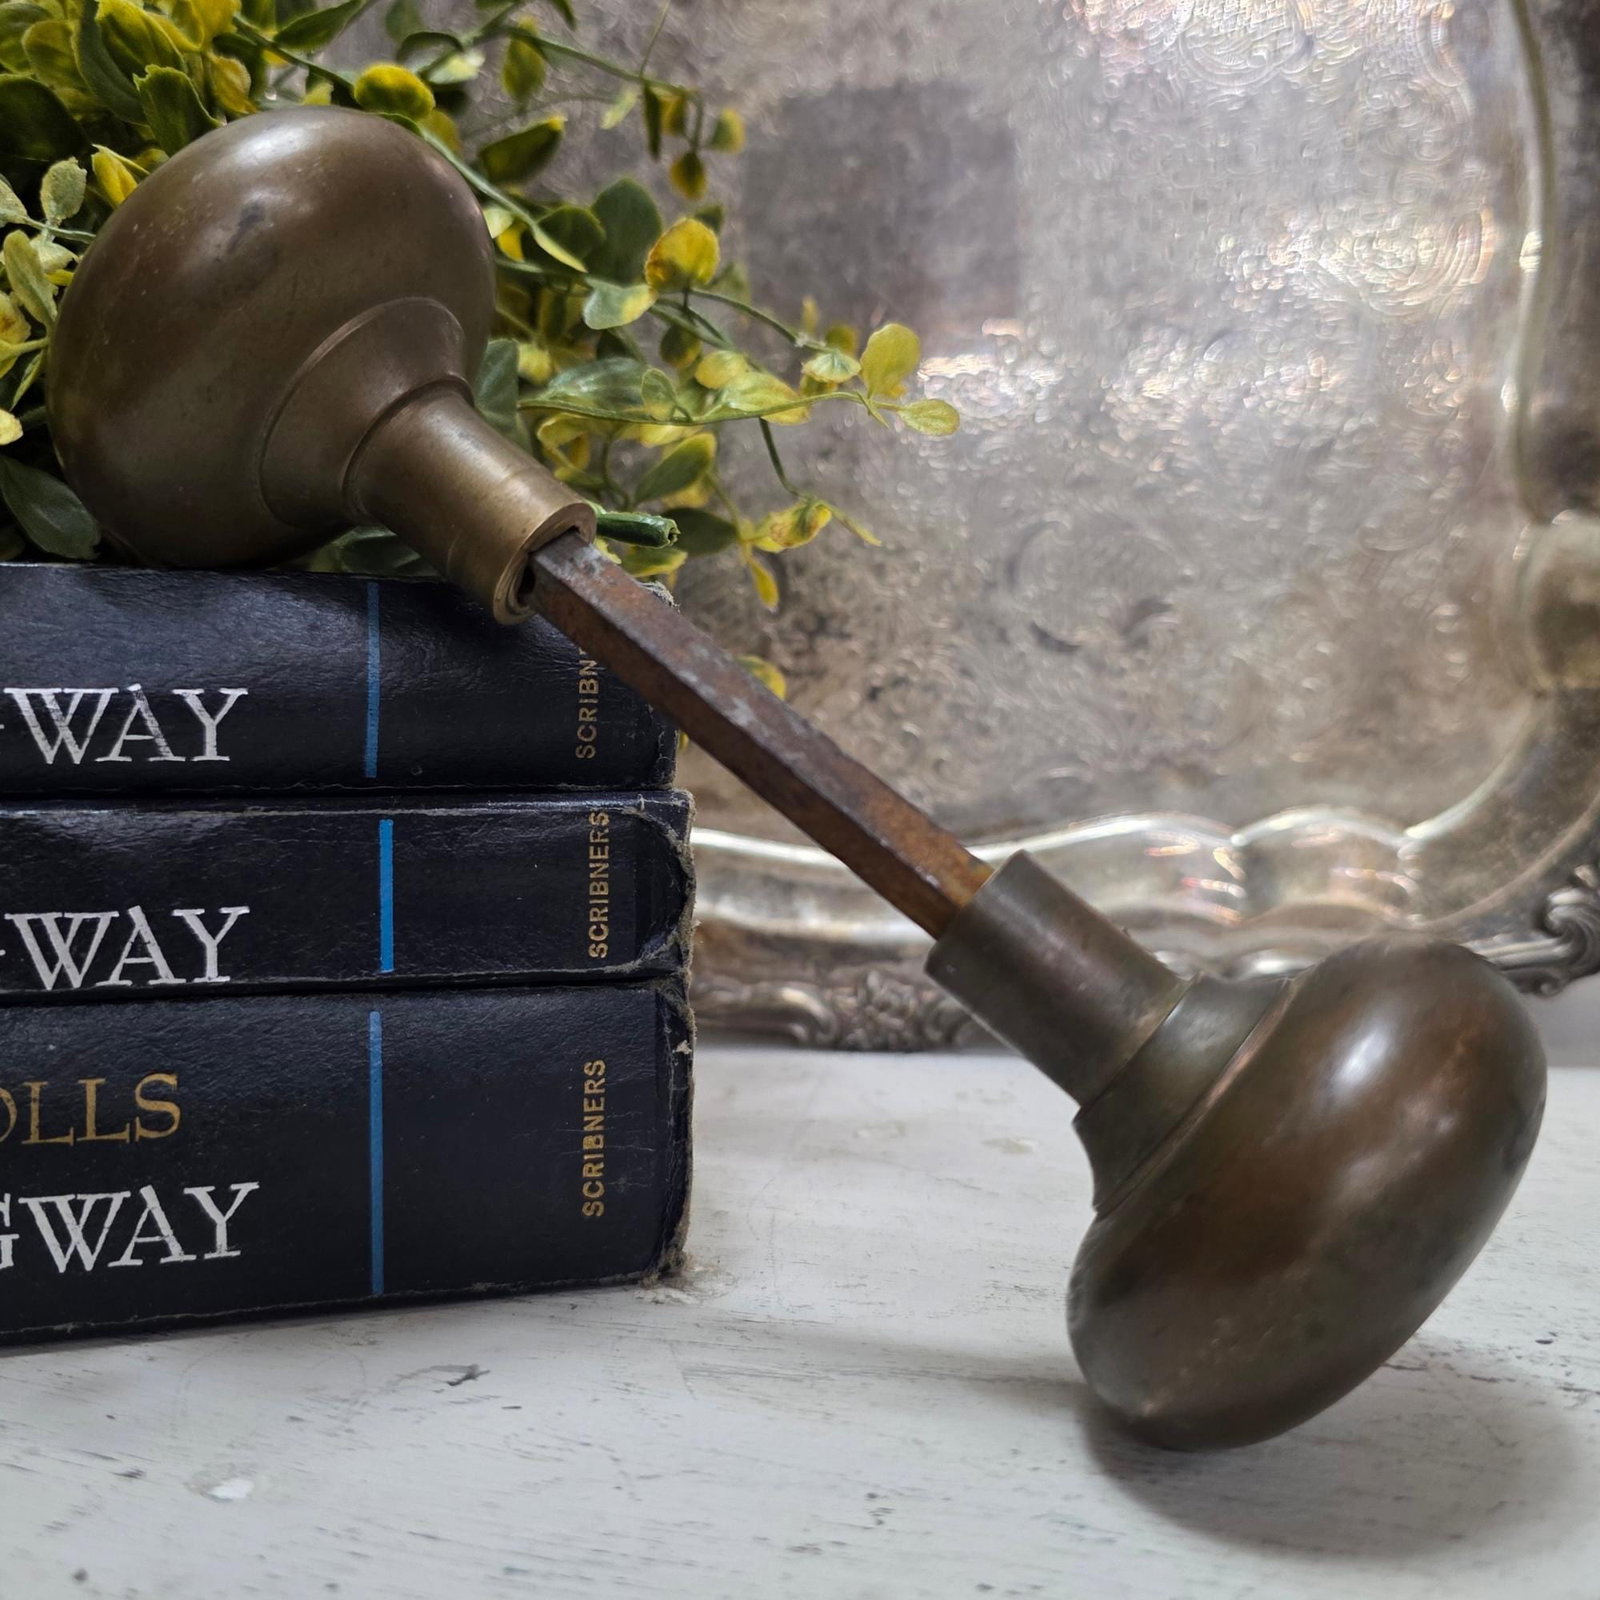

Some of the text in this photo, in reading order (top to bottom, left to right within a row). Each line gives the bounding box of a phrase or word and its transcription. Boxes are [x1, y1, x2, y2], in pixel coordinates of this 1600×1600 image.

[0, 683, 249, 764] WAY
[576, 647, 599, 759] SCRIBN
[588, 811, 610, 959] SCRIBNERS
[0, 905, 250, 990] WAY
[582, 1059, 606, 1217] SCRIBNERS
